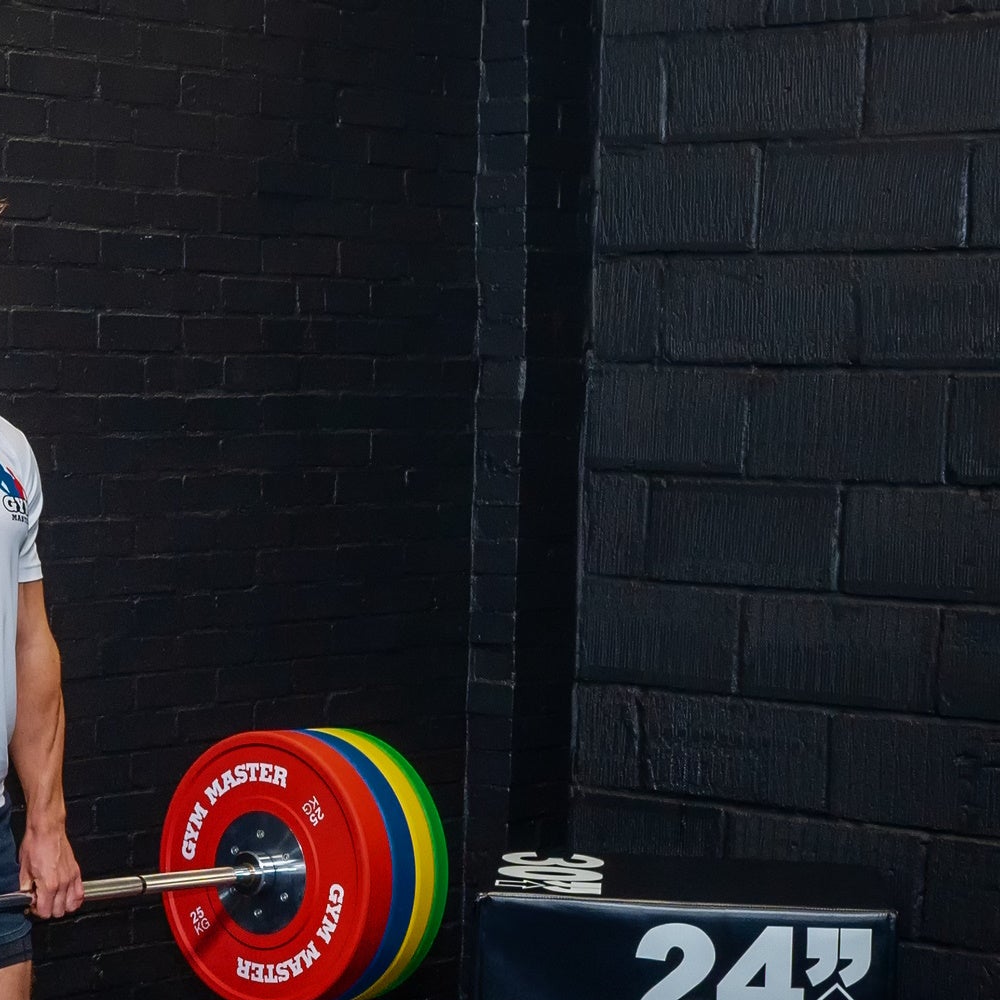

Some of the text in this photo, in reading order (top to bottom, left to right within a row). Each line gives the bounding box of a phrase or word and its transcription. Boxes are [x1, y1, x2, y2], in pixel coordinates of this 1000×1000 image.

[182, 763, 288, 860] GYM MASTER
[302, 796, 319, 814] KG
[310, 807, 324, 826] 25
[190, 906, 205, 924] 25
[194, 918, 211, 936] KG
[236, 884, 345, 984] GYM MASTER
